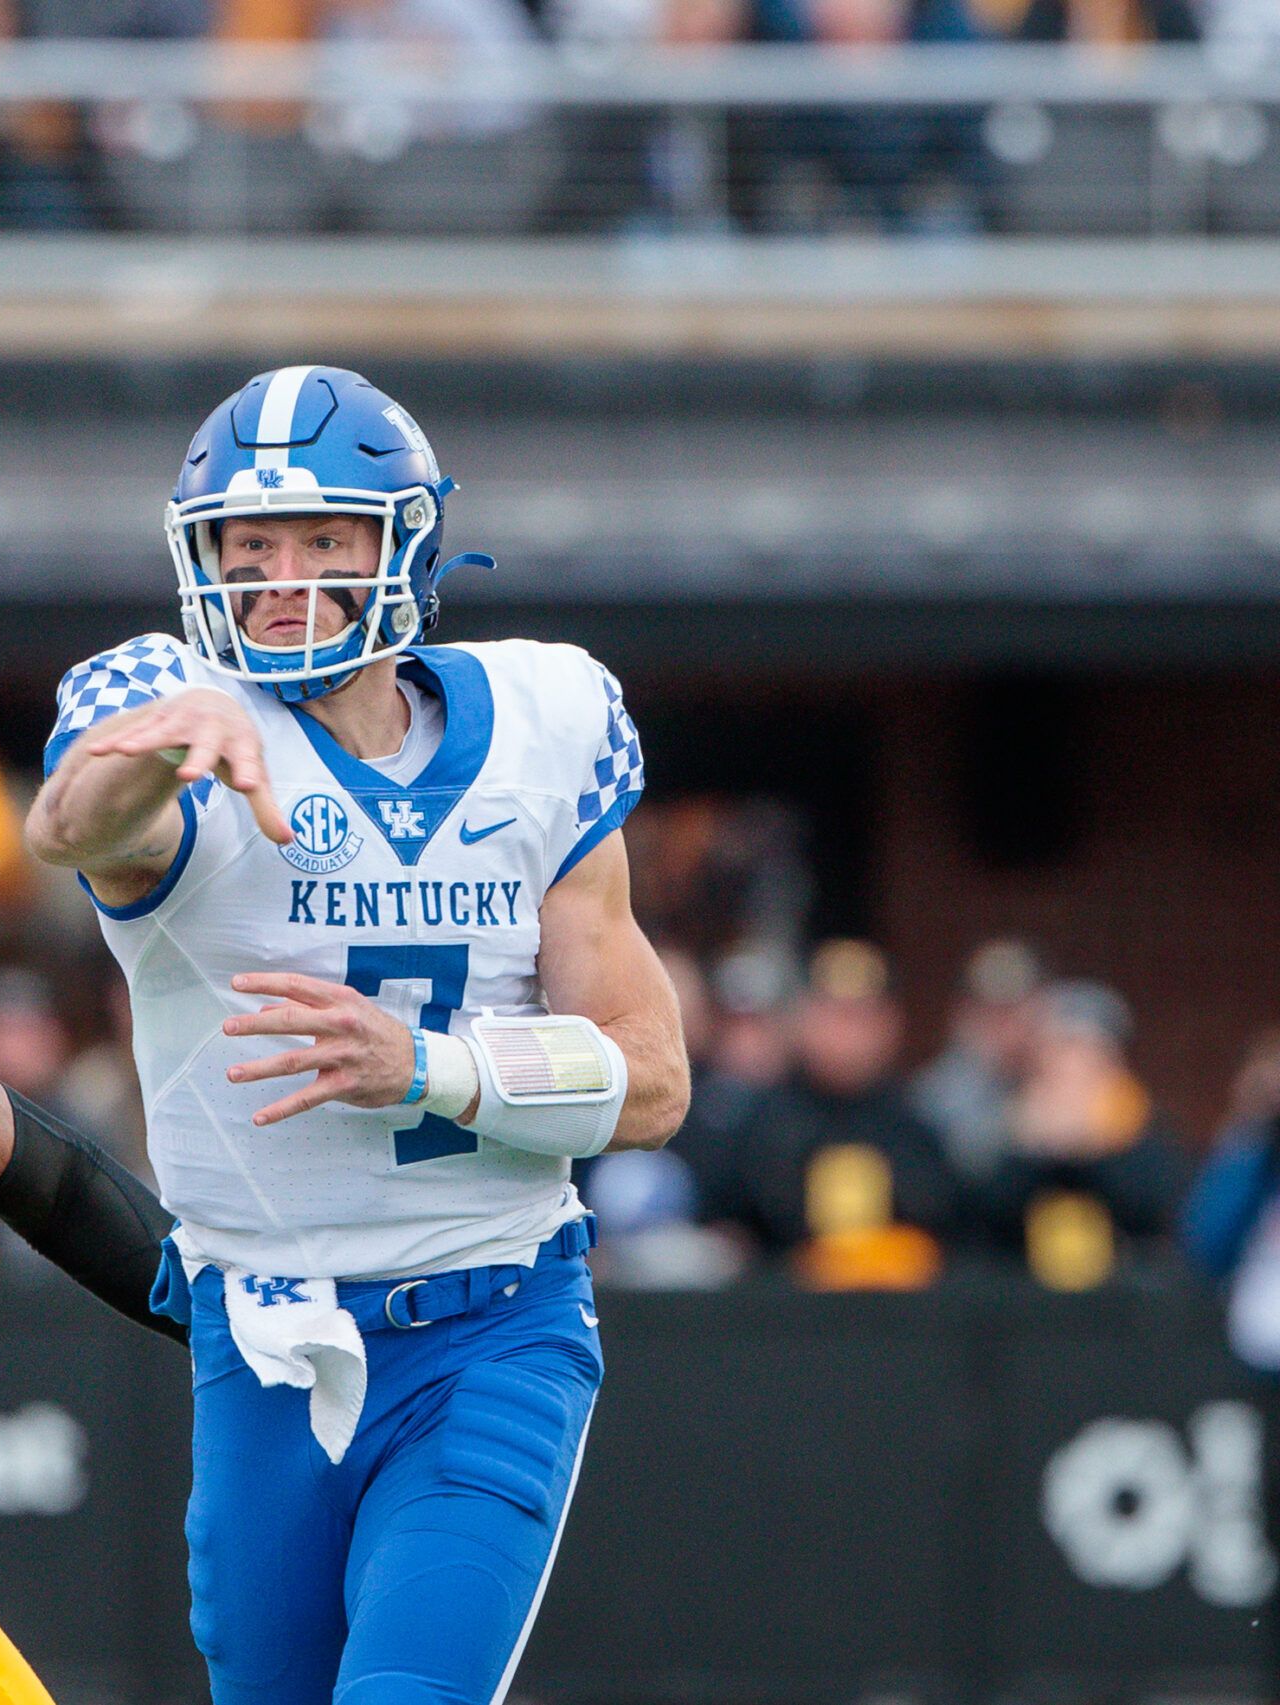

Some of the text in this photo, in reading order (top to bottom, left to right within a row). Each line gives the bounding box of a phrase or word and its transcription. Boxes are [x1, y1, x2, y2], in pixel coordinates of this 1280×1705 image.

[256, 468, 284, 489] UK
[294, 797, 345, 853] SEC
[377, 800, 426, 839] UK
[286, 846, 353, 872] GRADUATE
[288, 880, 522, 927] KENTUCKY
[344, 942, 480, 1168] 7
[239, 1273, 312, 1307] UK
